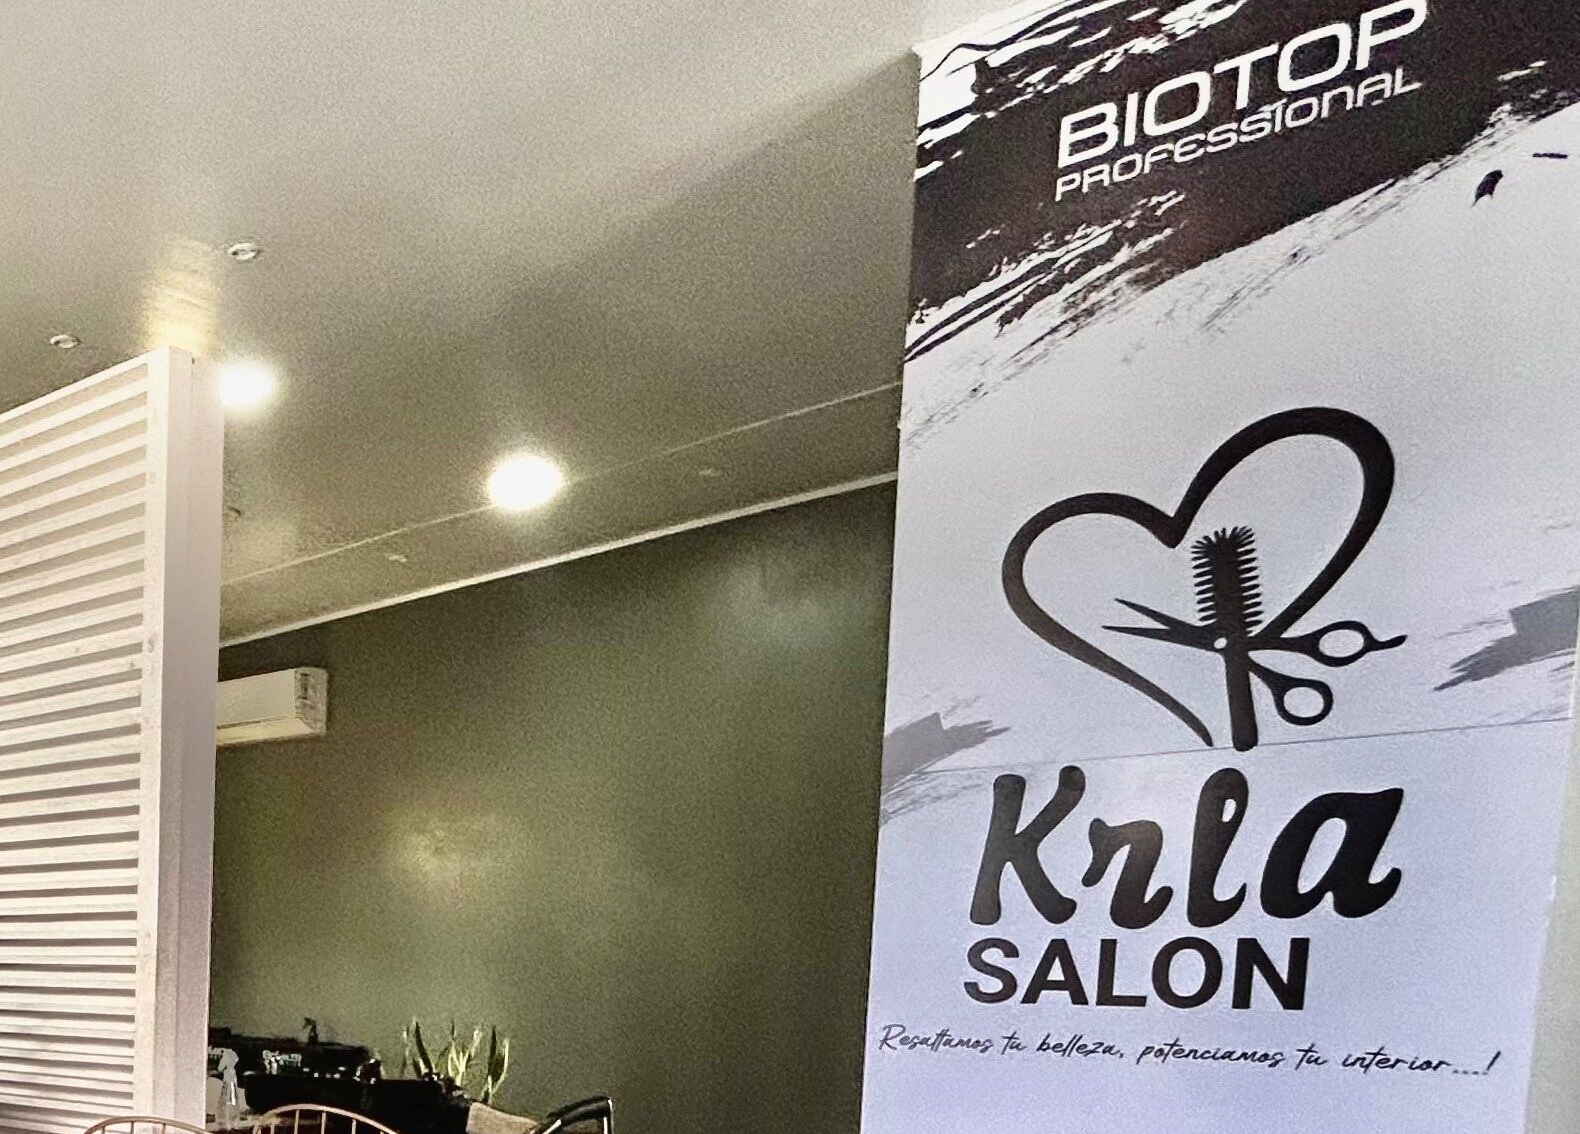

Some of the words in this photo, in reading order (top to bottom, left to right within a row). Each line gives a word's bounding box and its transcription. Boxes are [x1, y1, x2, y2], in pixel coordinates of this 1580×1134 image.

[1055, 66, 1423, 202] PROFESSIONAL
[1057, 0, 1428, 169] BIOTOP
[970, 765, 1405, 930] Krla
[963, 936, 1310, 1011] SALON
[879, 1024, 993, 1053] Resaltamos
[1001, 1030, 1027, 1055] tu
[1036, 1034, 1124, 1059] belleza,
[1136, 1037, 1285, 1069] potenciamos
[1295, 1044, 1328, 1071] tu
